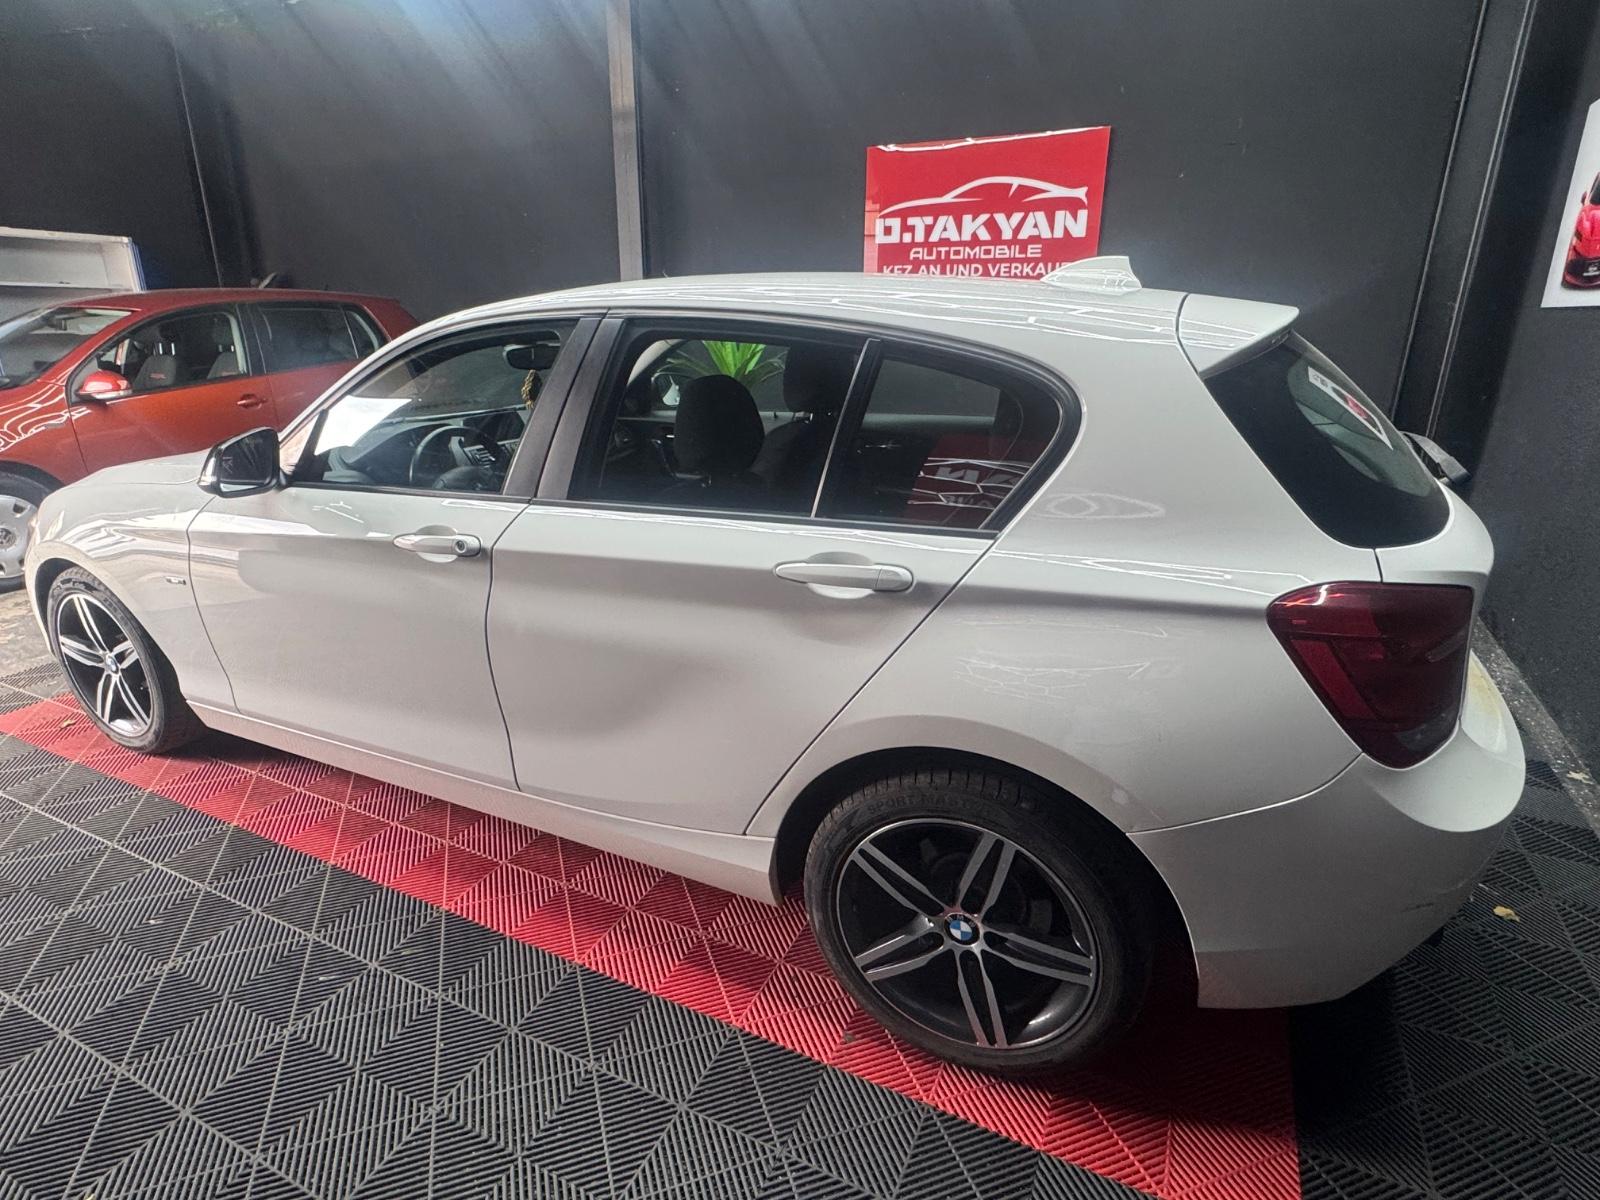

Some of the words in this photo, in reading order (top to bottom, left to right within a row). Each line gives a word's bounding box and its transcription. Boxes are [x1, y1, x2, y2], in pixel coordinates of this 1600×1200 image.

[909, 244, 1042, 260] AUTOMOBILE
[918, 264, 940, 276] AN
[946, 263, 983, 278] UND
